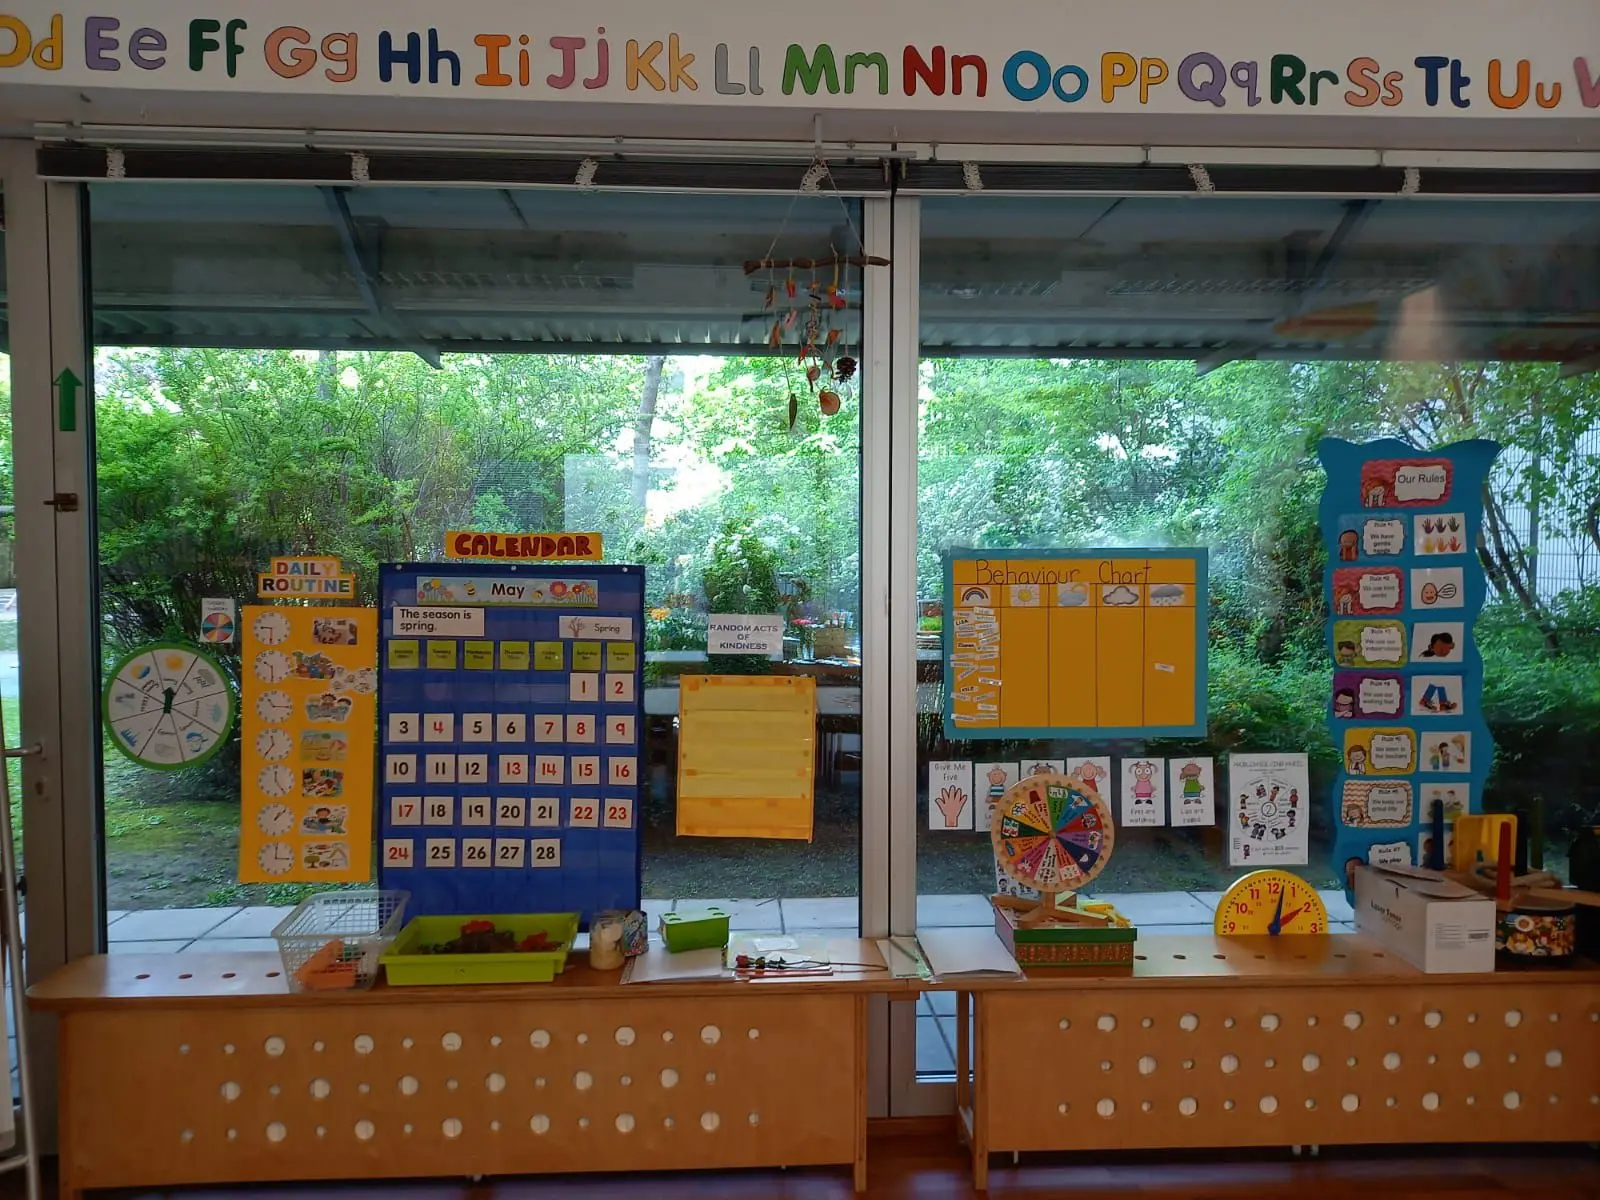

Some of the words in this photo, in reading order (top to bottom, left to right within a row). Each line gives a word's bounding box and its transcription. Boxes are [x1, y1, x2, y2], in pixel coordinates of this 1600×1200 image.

[0, 14, 63, 71] Dd
[84, 16, 167, 71] Ee
[189, 18, 247, 78] Ff
[264, 26, 358, 83] Gg
[378, 28, 460, 85] Hh
[474, 33, 530, 87] Ii
[546, 26, 609, 90] Jj
[626, 32, 698, 93] Kk
[715, 43, 764, 96] Ll
[782, 43, 889, 95] Mm
[903, 45, 987, 97] Nn
[1002, 50, 1089, 103] Oo
[1100, 51, 1170, 105] Pp
[1177, 52, 1262, 107] Qq
[1269, 53, 1339, 106] Rr
[1344, 56, 1403, 107] Ss
[1414, 56, 1471, 108] Tt
[1488, 59, 1562, 109] Uu
[1397, 474, 1415, 484] Our
[1418, 473, 1446, 484] Rules
[454, 533, 593, 558] CALENDAR
[276, 561, 333, 577] DAILY
[975, 559, 1081, 585] Behaviour
[1098, 560, 1152, 585] Chart
[262, 577, 351, 593] ROUTINE
[491, 582, 526, 600] May
[400, 608, 420, 619] The
[422, 610, 461, 620] season
[463, 609, 472, 620] is
[400, 620, 437, 633] spring.
[594, 622, 621, 634] Spring
[710, 624, 752, 632] RANDOM
[753, 625, 779, 633] ACTS
[737, 633, 751, 641] OF
[719, 642, 768, 650] KINDNESS
[581, 681, 586, 694] 1
[614, 681, 624, 695] 2
[399, 720, 409, 734] 3
[433, 721, 444, 734] 4
[472, 720, 483, 734] 5
[506, 721, 516, 735] 6
[544, 722, 554, 735] 7
[576, 722, 586, 735] 8
[615, 722, 626, 735] 9
[393, 761, 409, 775] 10
[435, 762, 446, 775] 11
[465, 762, 481, 776] 12
[506, 762, 521, 776] 13
[542, 763, 557, 776] 14
[578, 763, 593, 777] 15
[616, 764, 630, 777] 16
[398, 804, 414, 818] 17
[431, 804, 446, 818] 18
[468, 804, 484, 818] 19
[500, 805, 521, 819] 20
[537, 805, 553, 819] 21
[574, 806, 593, 820] 22
[608, 806, 627, 820] 23
[388, 847, 409, 860] 24
[431, 846, 451, 860] 25
[467, 846, 487, 860] 26
[500, 846, 520, 860] 27
[536, 846, 556, 860] 28
[1250, 888, 1260, 900] 11
[1267, 882, 1280, 895] 12
[1291, 886, 1296, 898] 1
[1235, 902, 1248, 915] 10
[1303, 901, 1312, 913] 2
[1370, 899, 1386, 914] Laser
[1386, 908, 1402, 922] Toner
[1228, 921, 1236, 933] 9
[1310, 922, 1318, 934] 3
